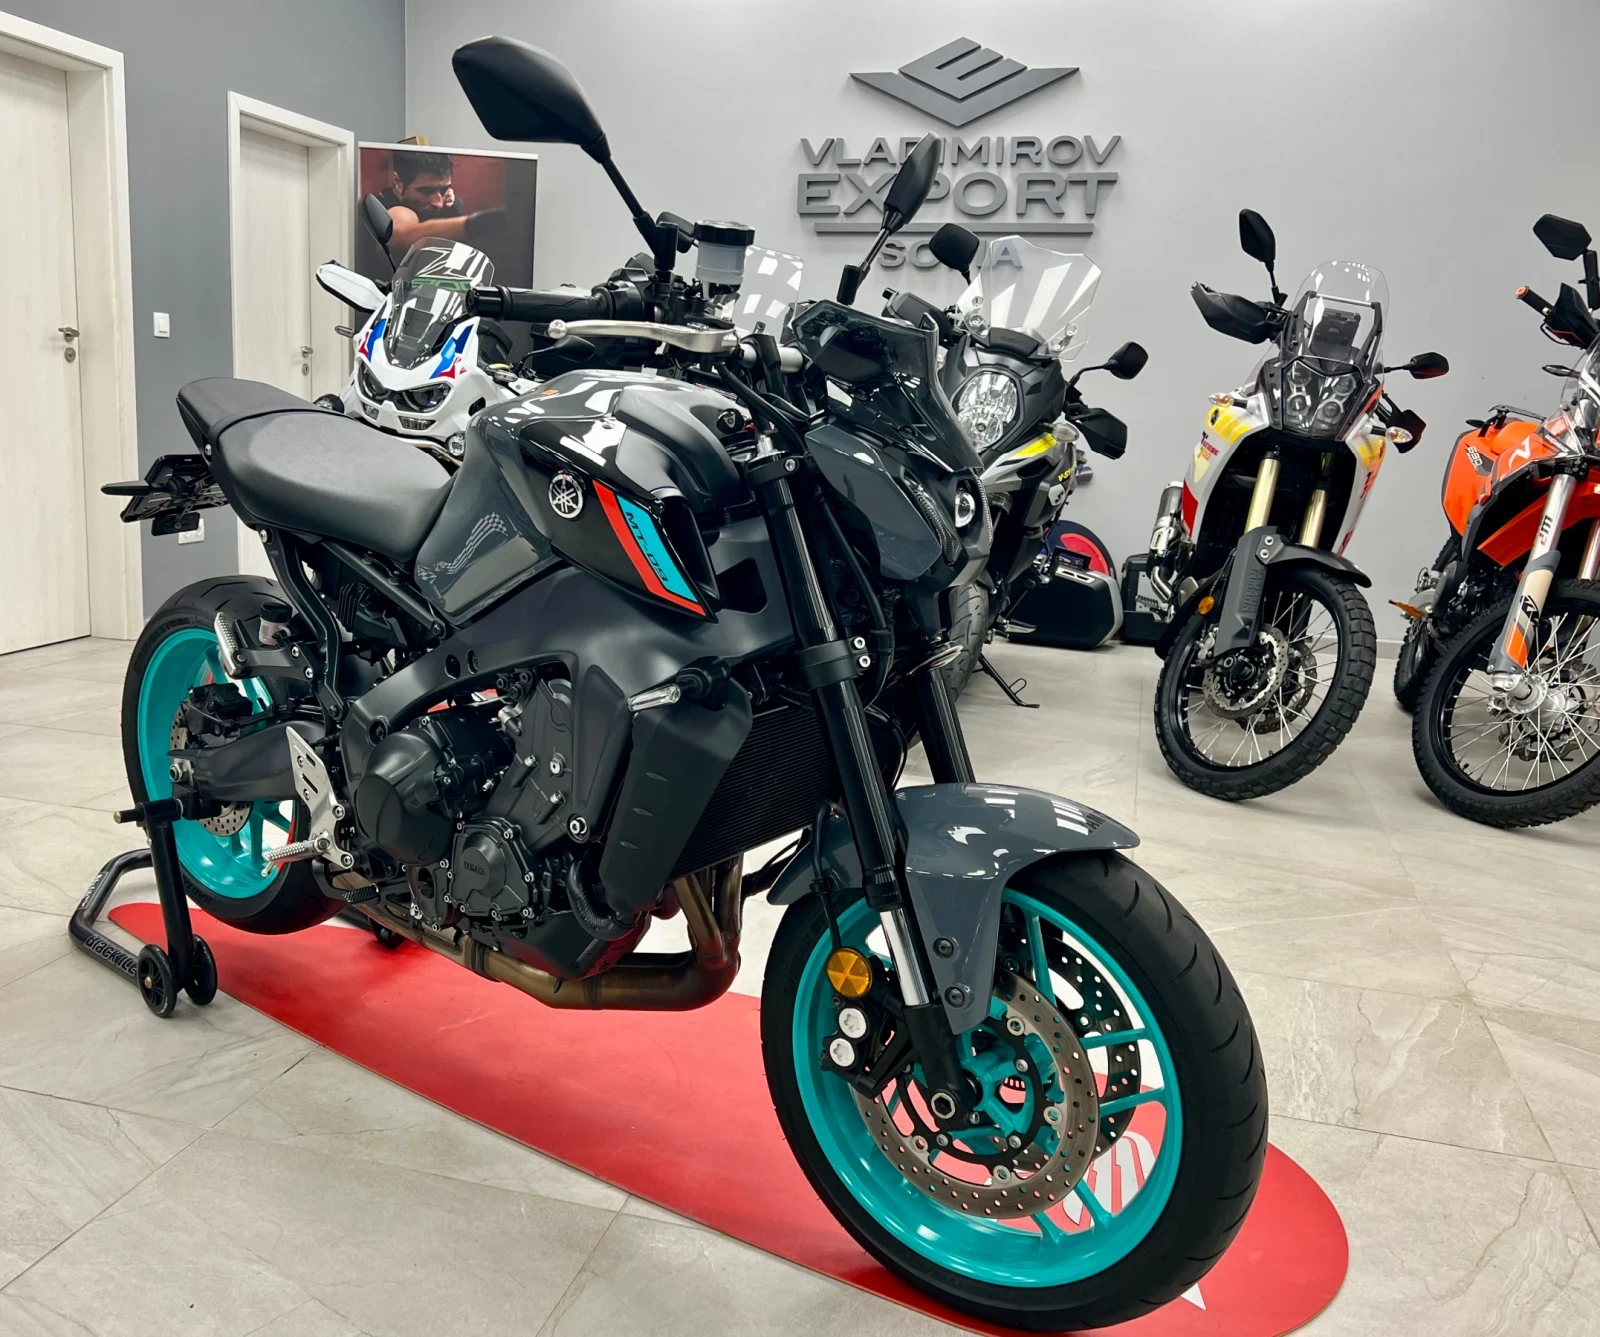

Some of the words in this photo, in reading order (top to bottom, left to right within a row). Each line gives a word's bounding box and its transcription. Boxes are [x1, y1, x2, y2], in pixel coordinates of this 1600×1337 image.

[878, 239, 1022, 269] SOIA
[625, 511, 669, 583] MT-09
[1241, 567, 1265, 615] YAMAHA
